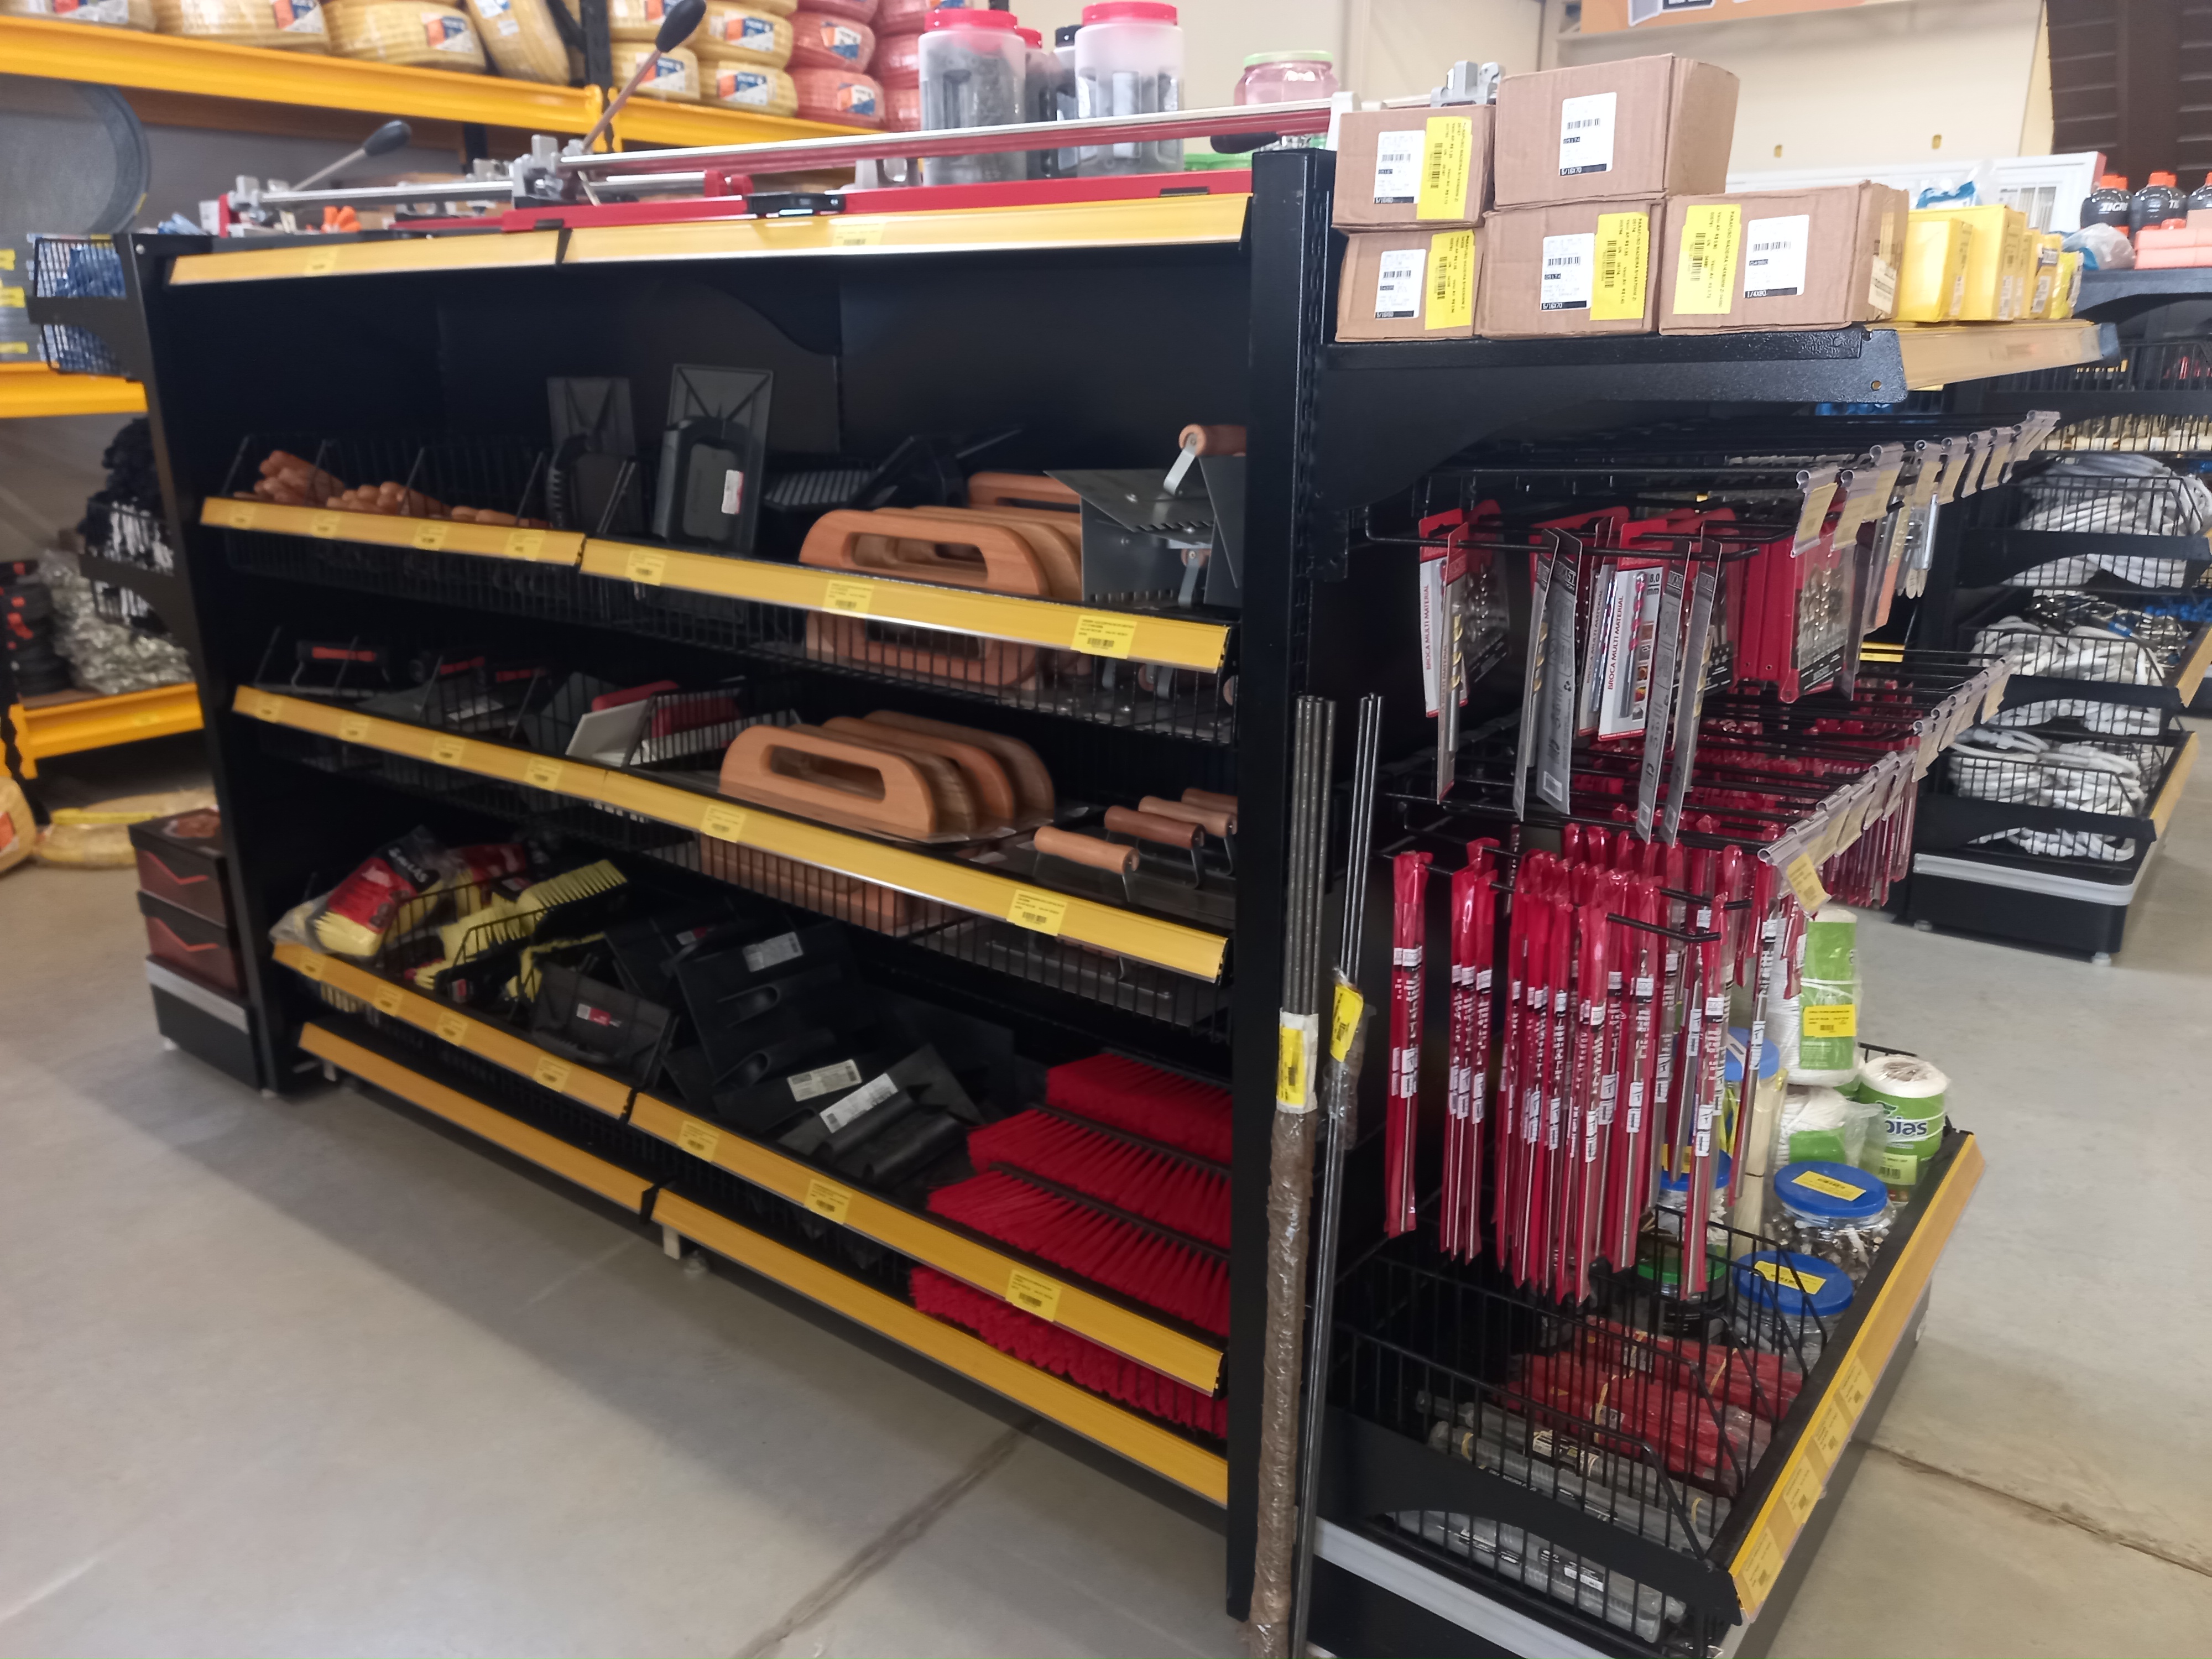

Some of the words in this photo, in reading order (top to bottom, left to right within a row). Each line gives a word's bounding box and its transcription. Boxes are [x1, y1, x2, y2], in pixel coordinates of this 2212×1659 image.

[1561, 167, 1582, 175] 5/16X70
[1594, 589, 1603, 627] MATERIAL
[1607, 662, 1616, 690] BROCA
[1614, 596, 1624, 634] MATERIAL
